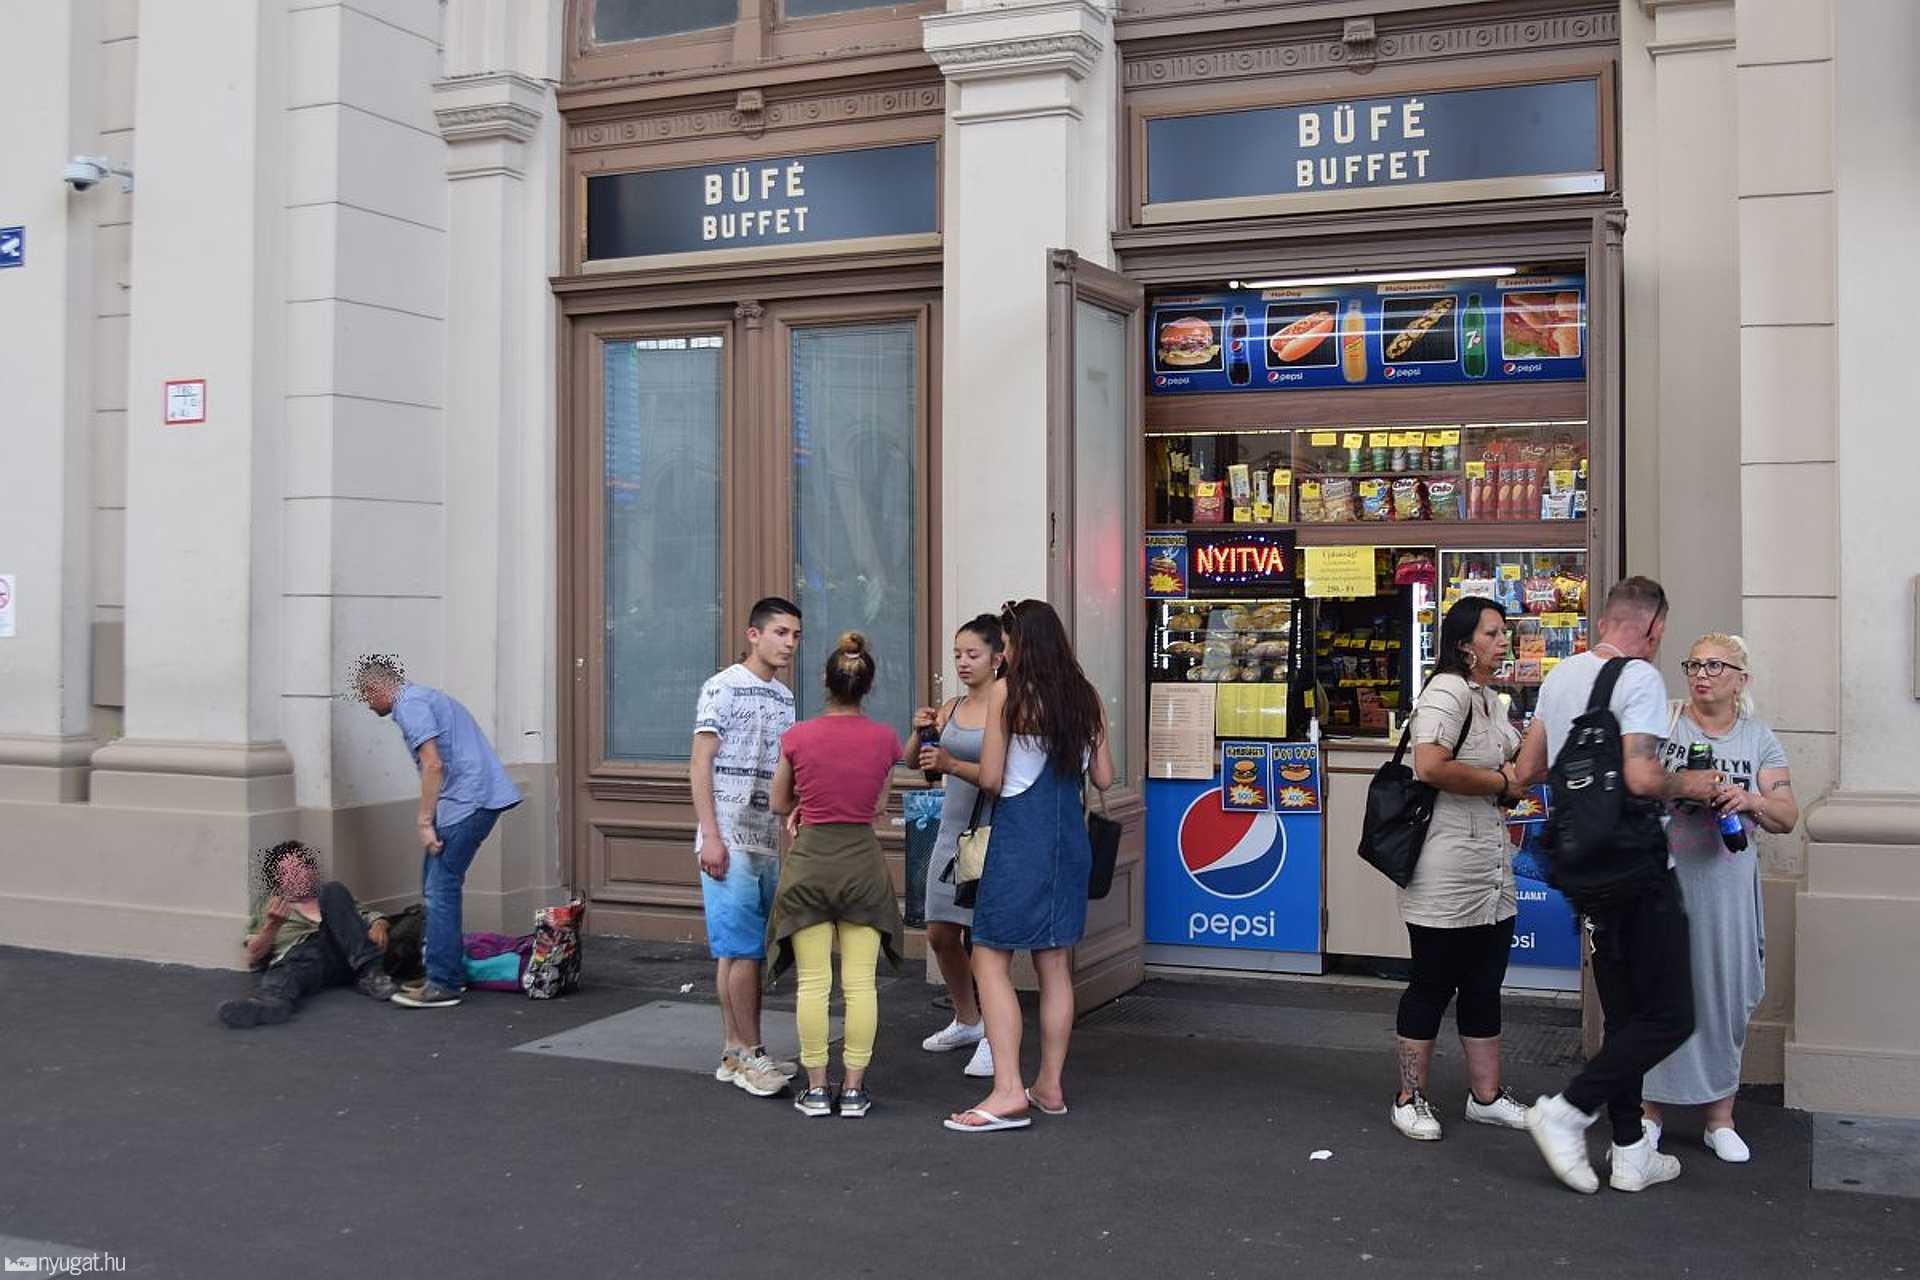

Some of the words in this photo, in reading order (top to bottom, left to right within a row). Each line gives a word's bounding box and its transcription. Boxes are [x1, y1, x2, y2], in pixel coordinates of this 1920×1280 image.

[1298, 98, 1425, 148] BÜFÉ
[704, 161, 805, 206] BÜFÉ
[1296, 149, 1430, 188] BUFFET
[703, 207, 809, 241] BUFFET
[1167, 376, 1190, 386] pepsi
[1279, 371, 1303, 382] pepsi
[1396, 367, 1421, 378] pepsi
[1516, 363, 1542, 374] pepsi
[1197, 546, 1284, 573] NYITVA
[1666, 743, 1752, 774] BRKLYN
[1188, 911, 1276, 942] pepsi
